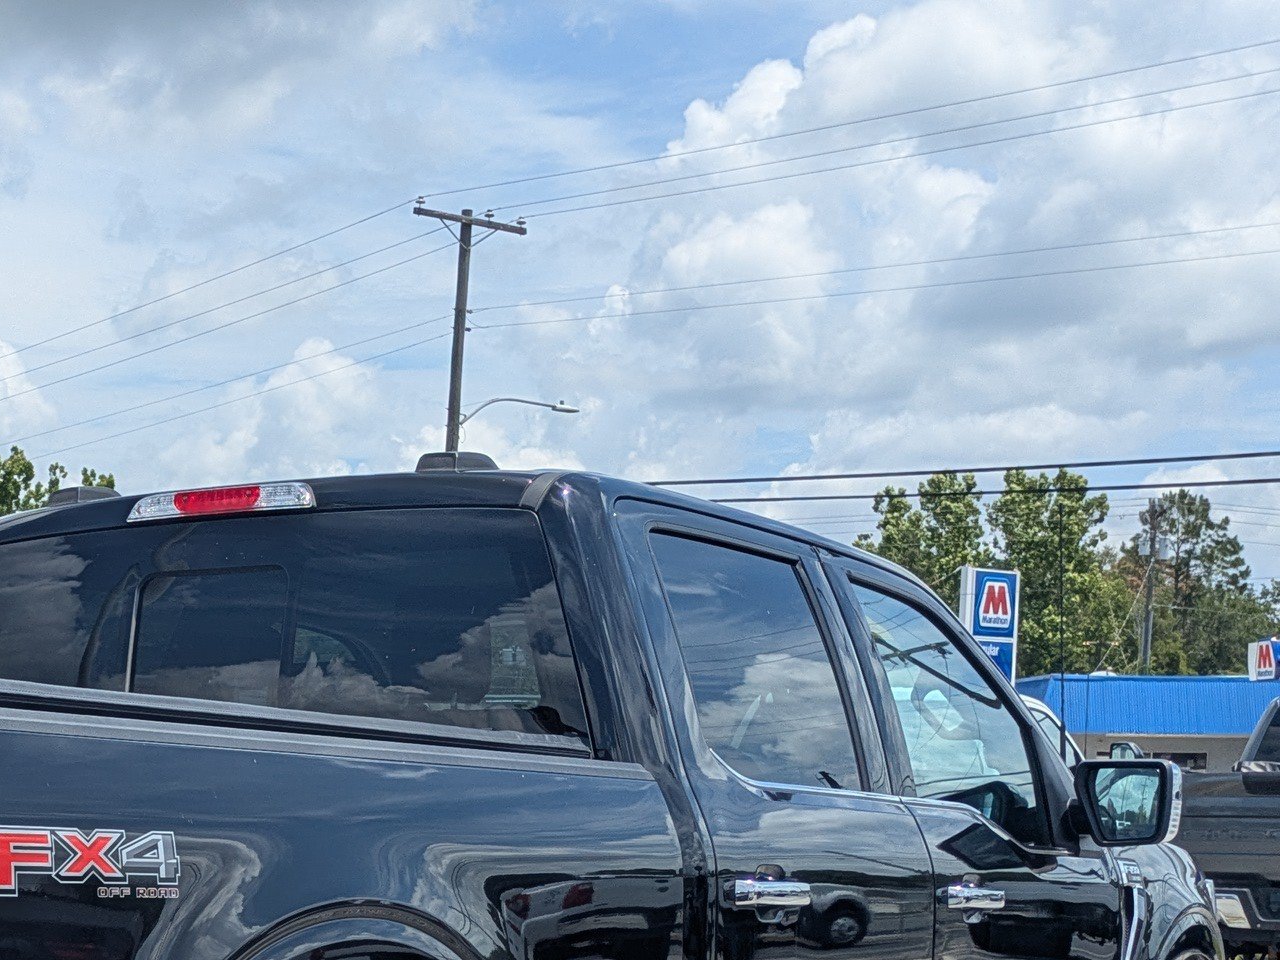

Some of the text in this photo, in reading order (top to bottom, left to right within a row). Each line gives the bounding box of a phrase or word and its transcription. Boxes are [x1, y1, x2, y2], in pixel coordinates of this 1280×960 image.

[981, 615, 1009, 625] Marathon
[97, 886, 180, 899] OFF ROAD
